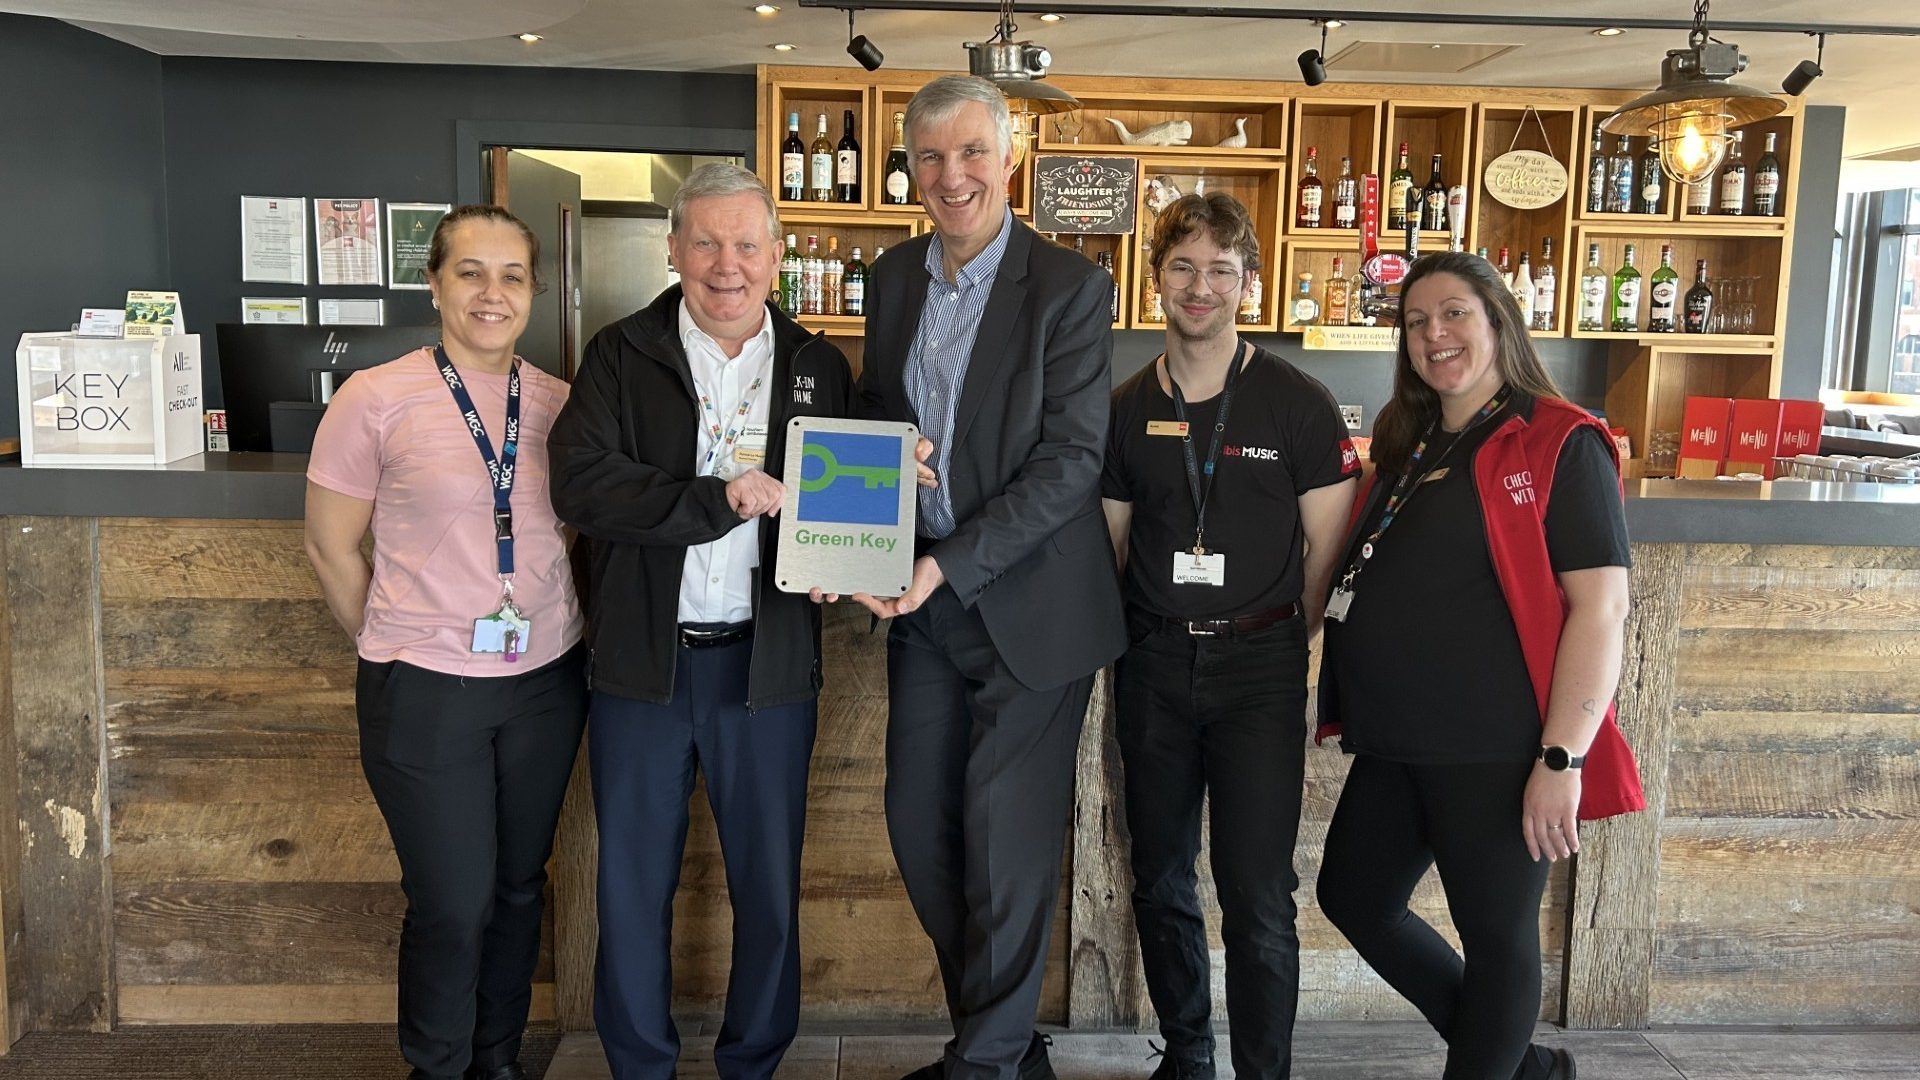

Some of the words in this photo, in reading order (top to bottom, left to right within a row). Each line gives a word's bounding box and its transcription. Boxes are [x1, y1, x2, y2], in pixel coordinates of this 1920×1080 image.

[1531, 158, 1546, 166] day
[1066, 173, 1106, 187] LOVE
[1057, 187, 1113, 196] LAUGHTER
[1056, 195, 1112, 209] FRIENDSHIP
[441, 364, 462, 389] WGC
[54, 373, 130, 398] KEY
[176, 384, 189, 395] FAST
[509, 373, 519, 397] WGC
[168, 396, 198, 412] CHECK-OUT
[802, 390, 812, 404] ME
[56, 406, 131, 431] BOX
[464, 410, 485, 437] WGC
[506, 416, 518, 441] WGC
[1223, 445, 1241, 456] ibis
[1241, 446, 1279, 461] MUSIC
[500, 463, 514, 490] WGC
[795, 529, 854, 547] Green
[860, 532, 897, 553] Key
[1176, 574, 1209, 582] WELCOME
